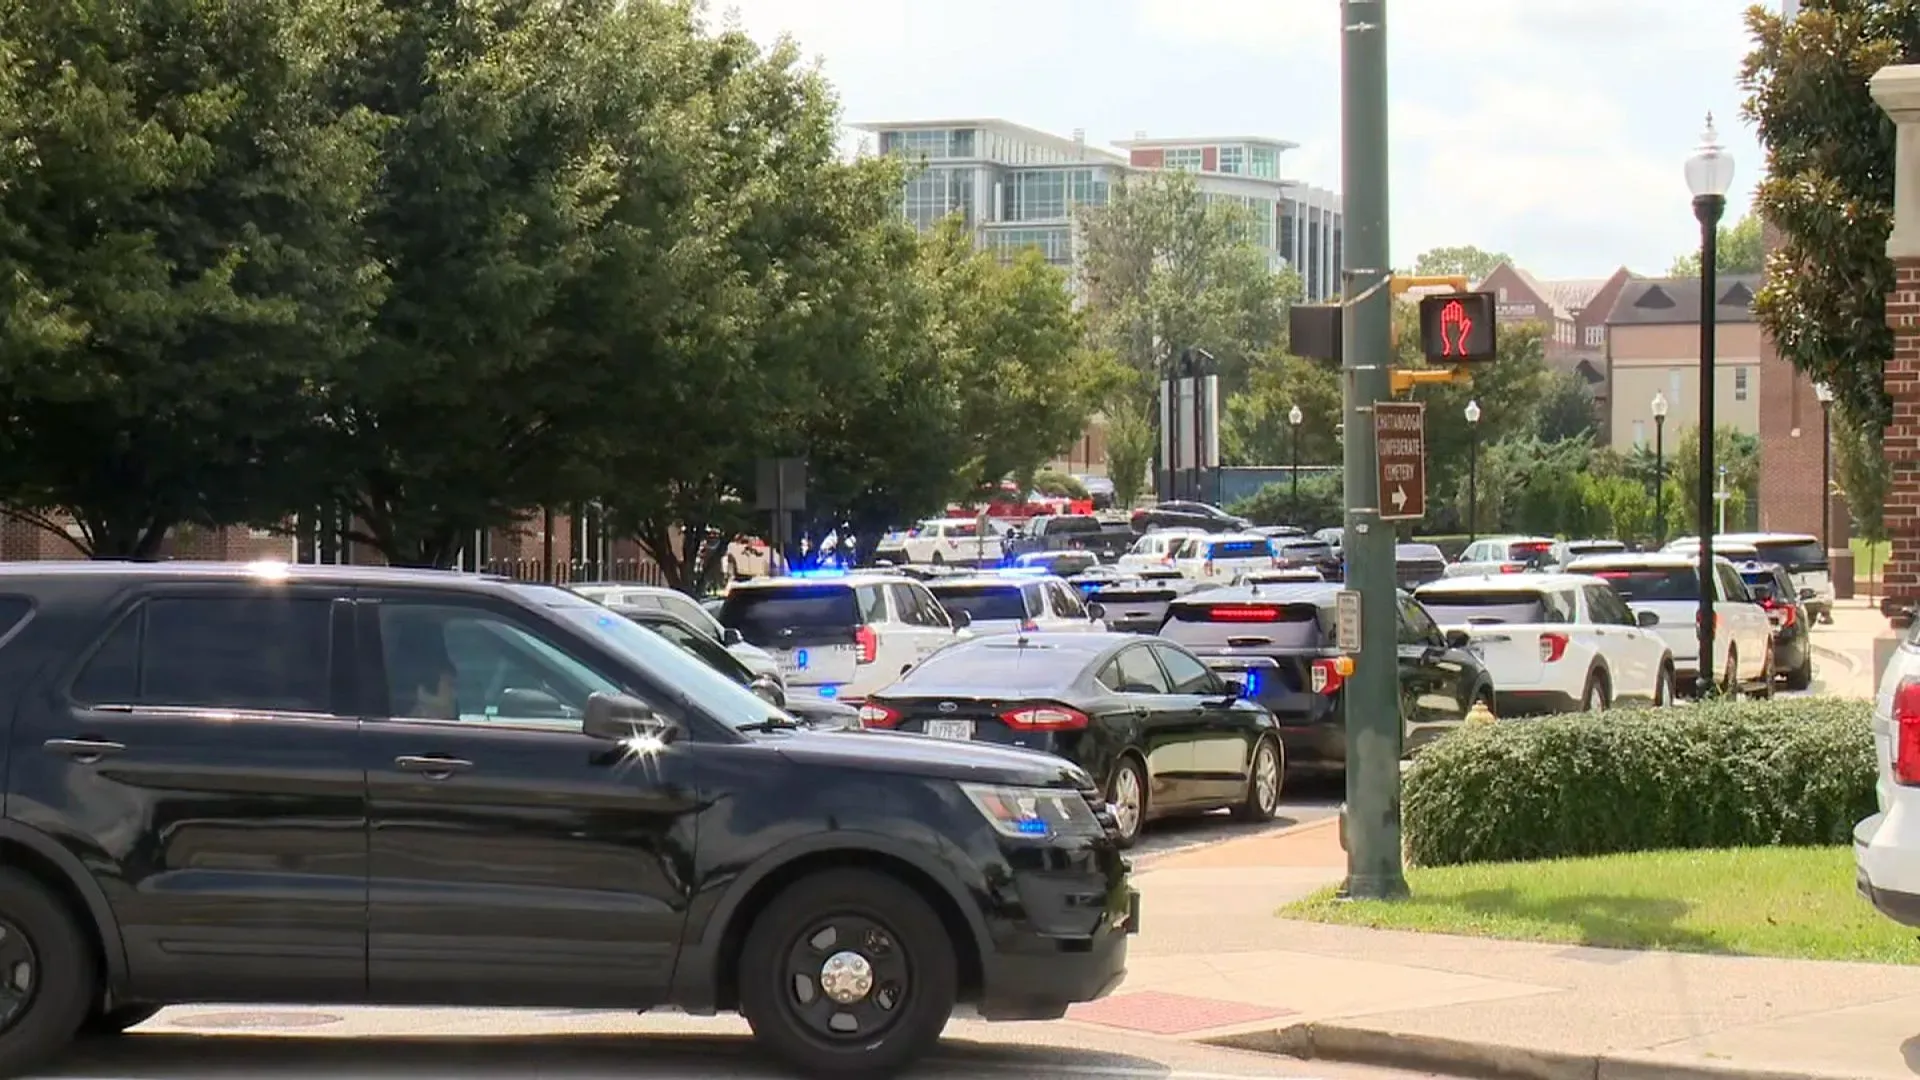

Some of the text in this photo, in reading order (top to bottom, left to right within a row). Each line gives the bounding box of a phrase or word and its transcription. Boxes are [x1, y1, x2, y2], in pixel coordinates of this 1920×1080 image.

[1378, 413, 1420, 431] CHATTANOOGA
[1379, 439, 1420, 456] CONFEDERATE
[1384, 464, 1415, 481] CEMETERY
